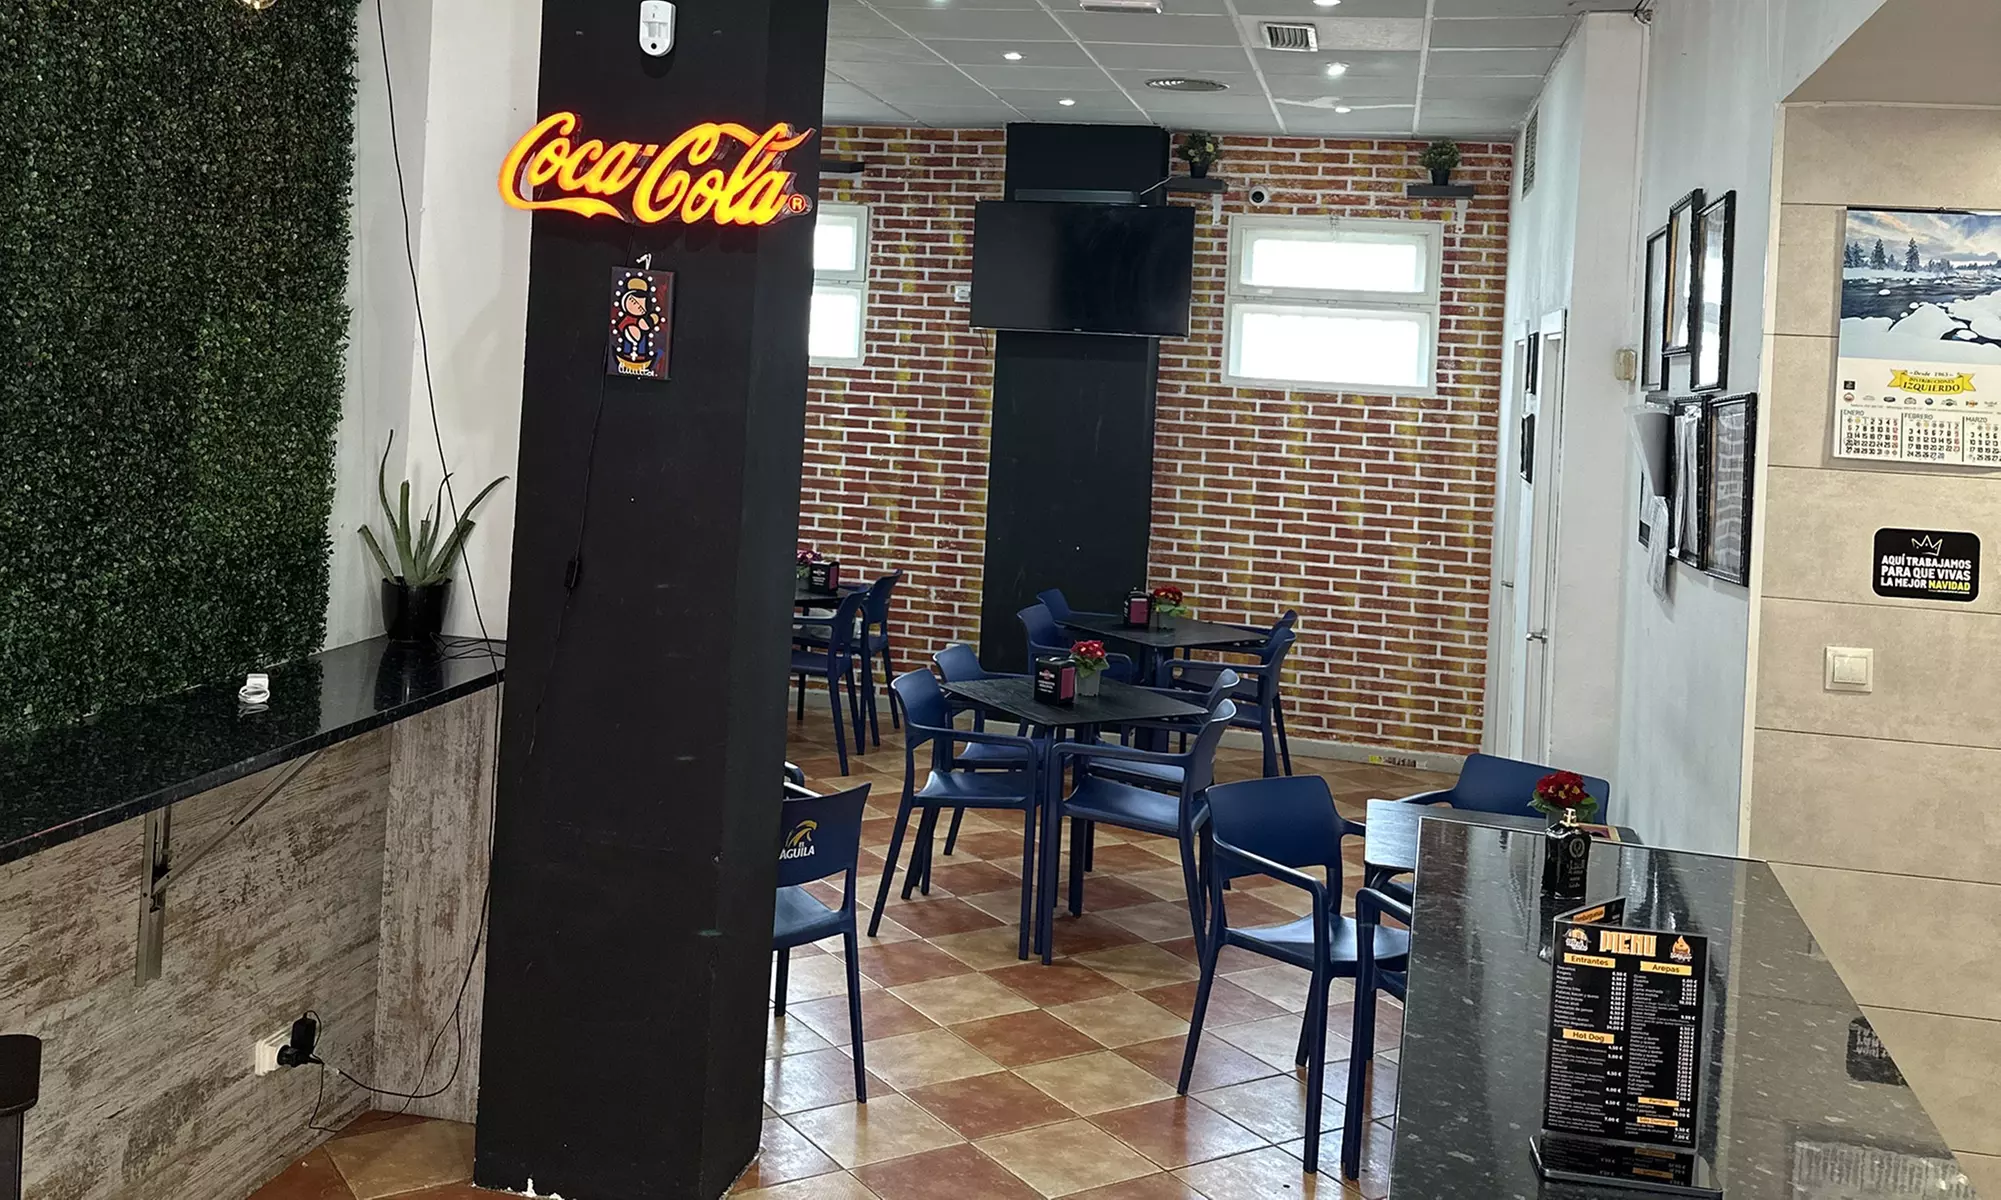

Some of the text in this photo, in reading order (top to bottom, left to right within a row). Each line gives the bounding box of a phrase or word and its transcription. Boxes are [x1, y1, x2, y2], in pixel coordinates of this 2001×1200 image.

[498, 111, 816, 226] Coca-Cola
[1903, 381, 1960, 393] IZQUIERDO
[1904, 412, 1933, 420] FEBRERO
[1881, 553, 1972, 569] AQUÍ TRABAJAMOS
[1881, 565, 1971, 581] PARA QUE VIVAS
[1880, 577, 1971, 591] LA MEJOR NAVIDAD
[778, 845, 815, 860] AGUILA
[1571, 955, 1609, 966] Entrantes
[1652, 964, 1680, 973] Arepas
[1589, 1034, 1604, 1042] Dog
